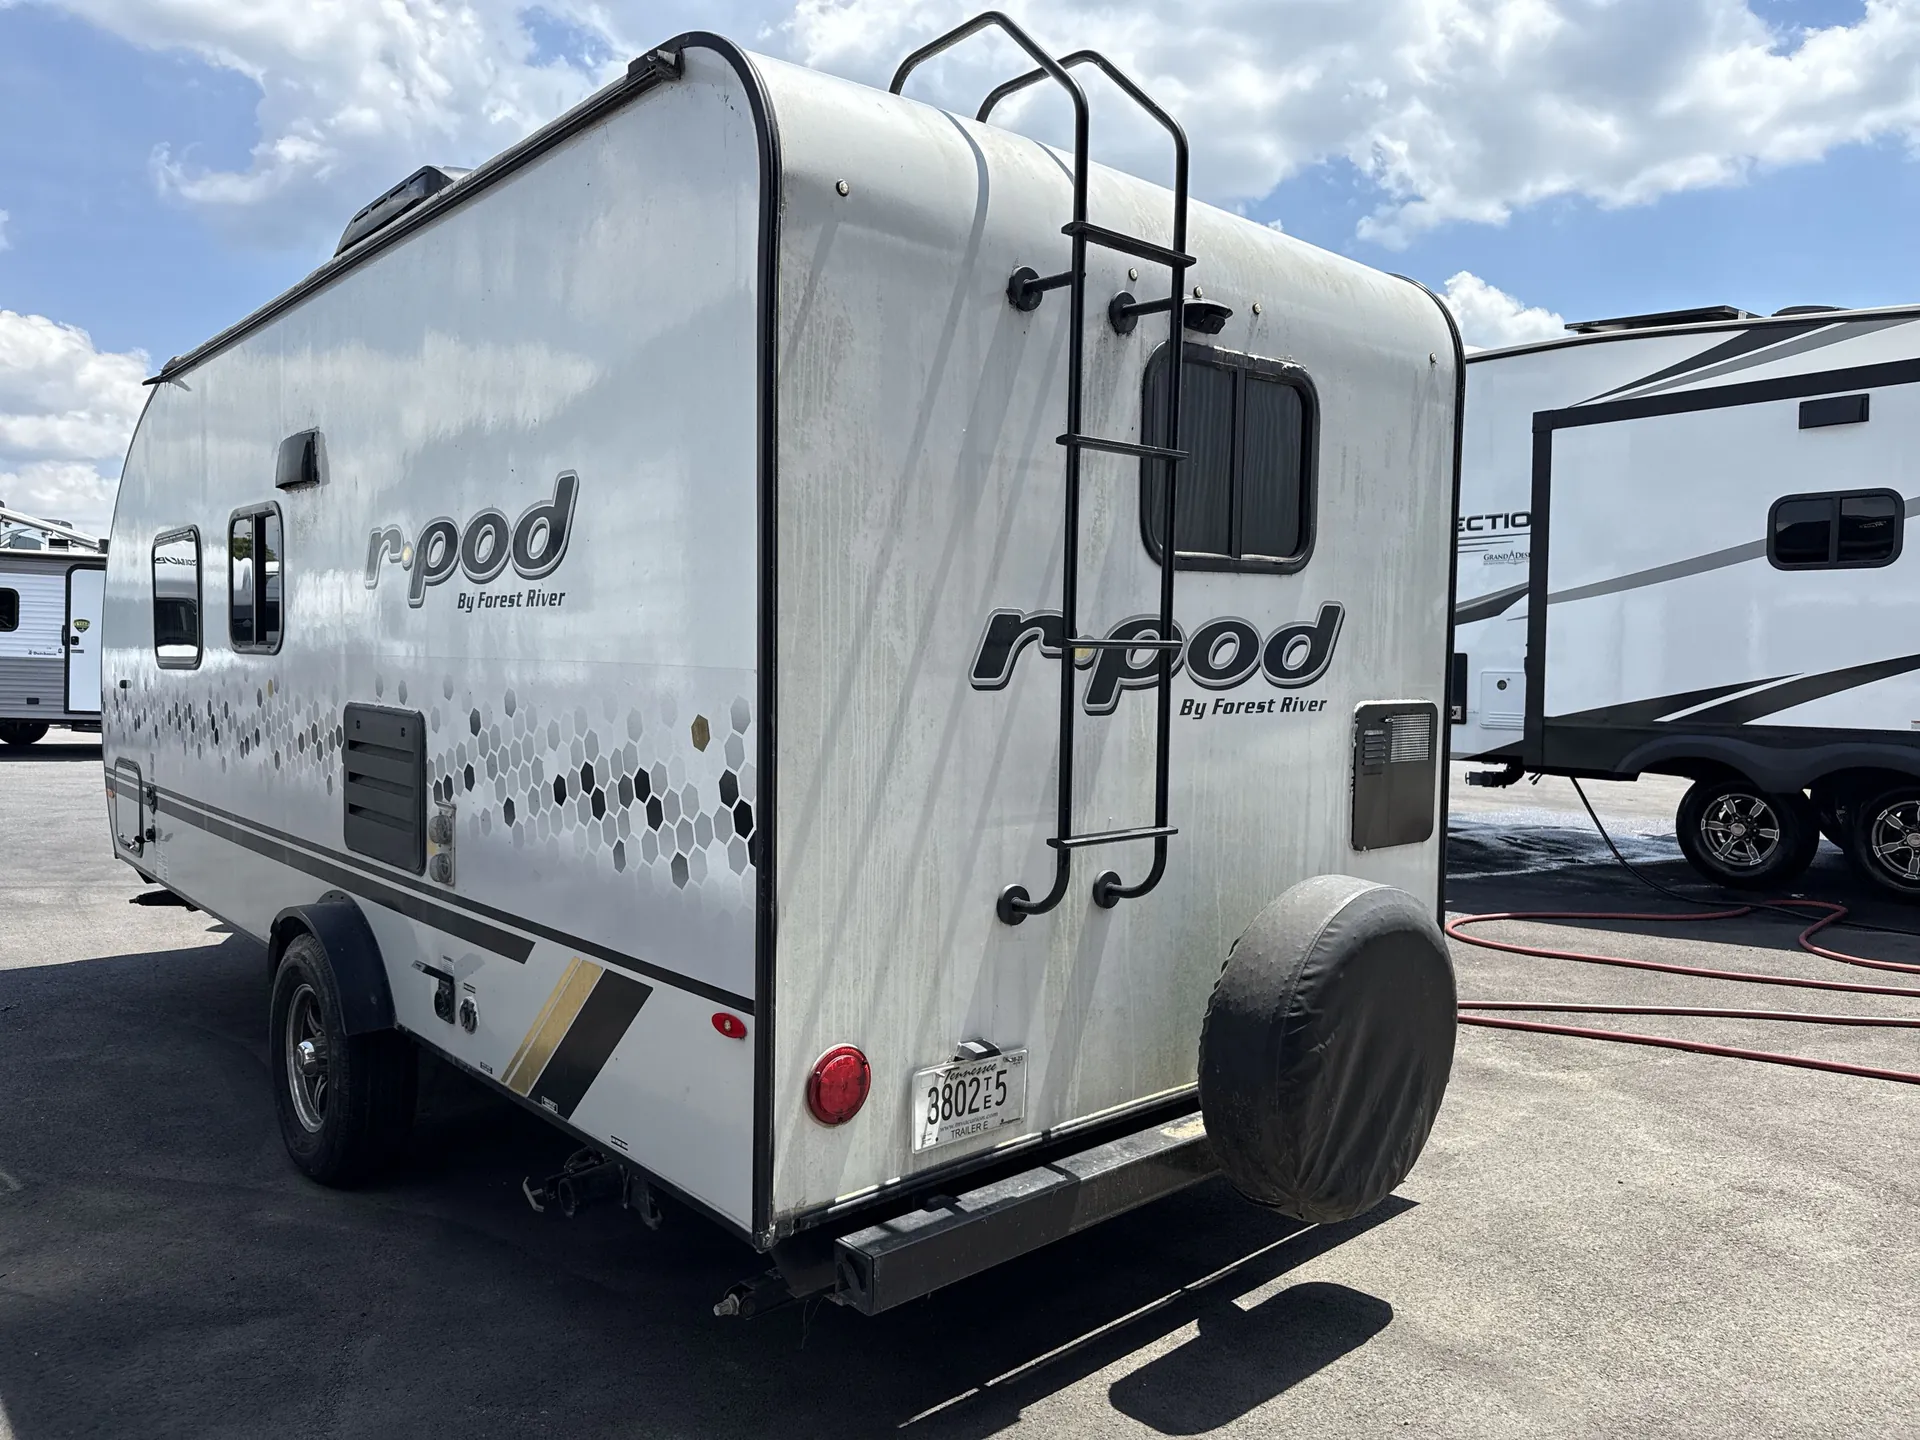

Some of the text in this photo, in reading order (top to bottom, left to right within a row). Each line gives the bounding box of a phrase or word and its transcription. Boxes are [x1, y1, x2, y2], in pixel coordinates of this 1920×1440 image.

[457, 589, 566, 613] By Forest River
[1179, 696, 1327, 720] By Forest River
[944, 1063, 997, 1084] Tennessee
[951, 1122, 982, 1139] TRAILER
[983, 1120, 989, 1130] E
